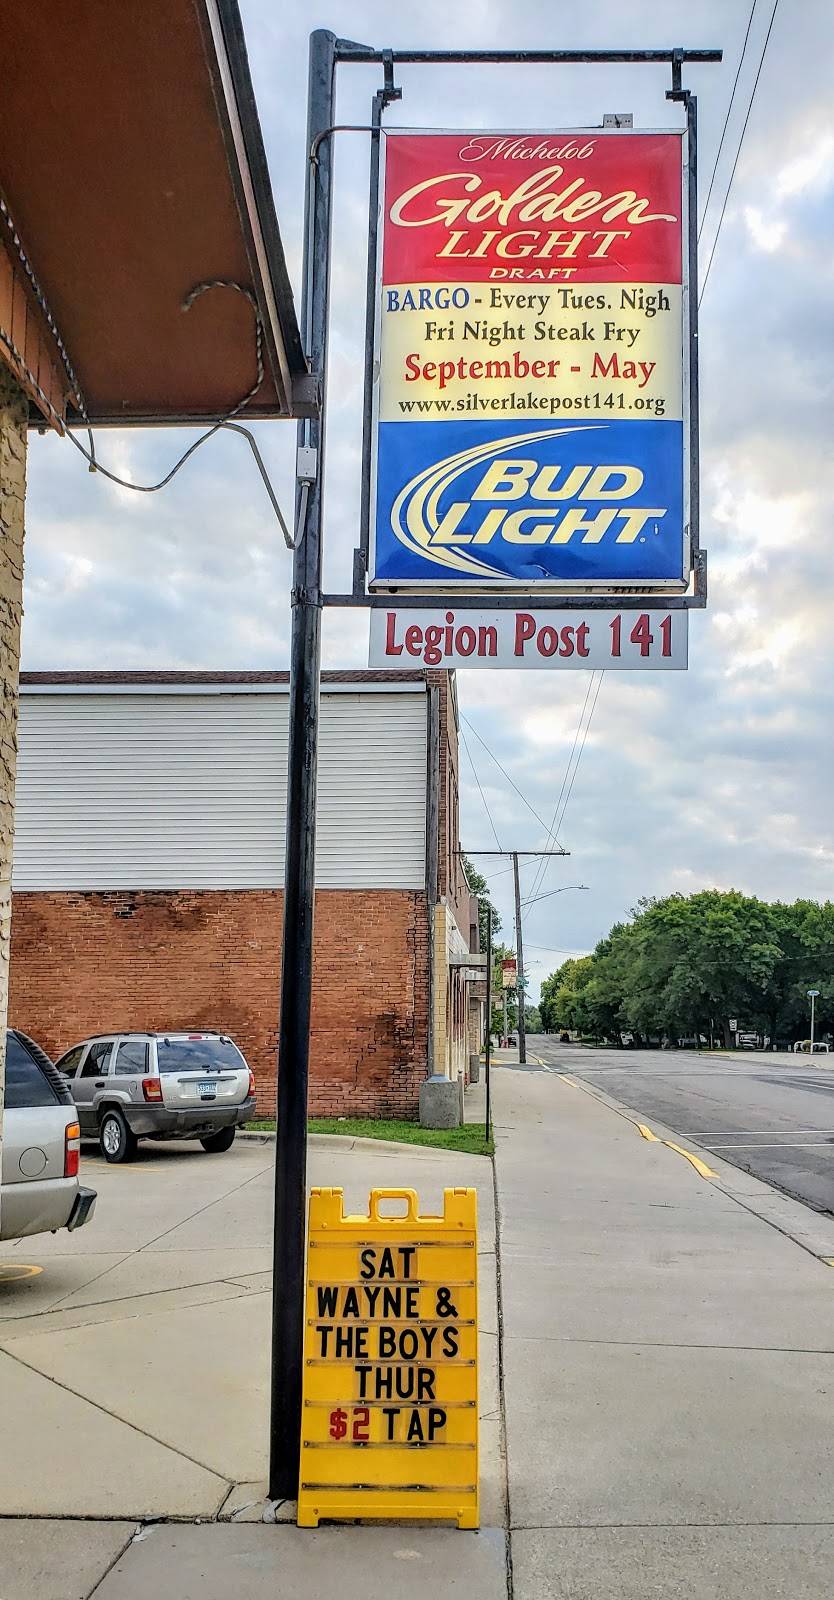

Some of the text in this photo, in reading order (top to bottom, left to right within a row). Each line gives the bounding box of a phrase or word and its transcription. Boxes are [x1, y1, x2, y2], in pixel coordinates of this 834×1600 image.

[459, 137, 597, 161] Michelob
[390, 165, 677, 227] Golden
[436, 231, 631, 258] LIGHT
[489, 268, 577, 278] DRAFT
[387, 287, 469, 312] BARGO
[489, 289, 550, 315] Every
[558, 289, 611, 310] Tues.
[619, 289, 670, 317] Nigh
[425, 321, 640, 347] Fri Night Steak Fry
[405, 351, 560, 389] September
[591, 352, 656, 388] May
[399, 392, 665, 415] www.silverlakepost141.org
[470, 460, 644, 501] BUD
[428, 502, 667, 545] LIGHT
[385, 612, 672, 665] Legion Post 141
[361, 1247, 415, 1279] SAT
[317, 1287, 458, 1318] WAYNE &
[316, 1326, 459, 1360] THE BOYS
[355, 1366, 435, 1399] THUR
[329, 1408, 447, 1441] $2 TAP
